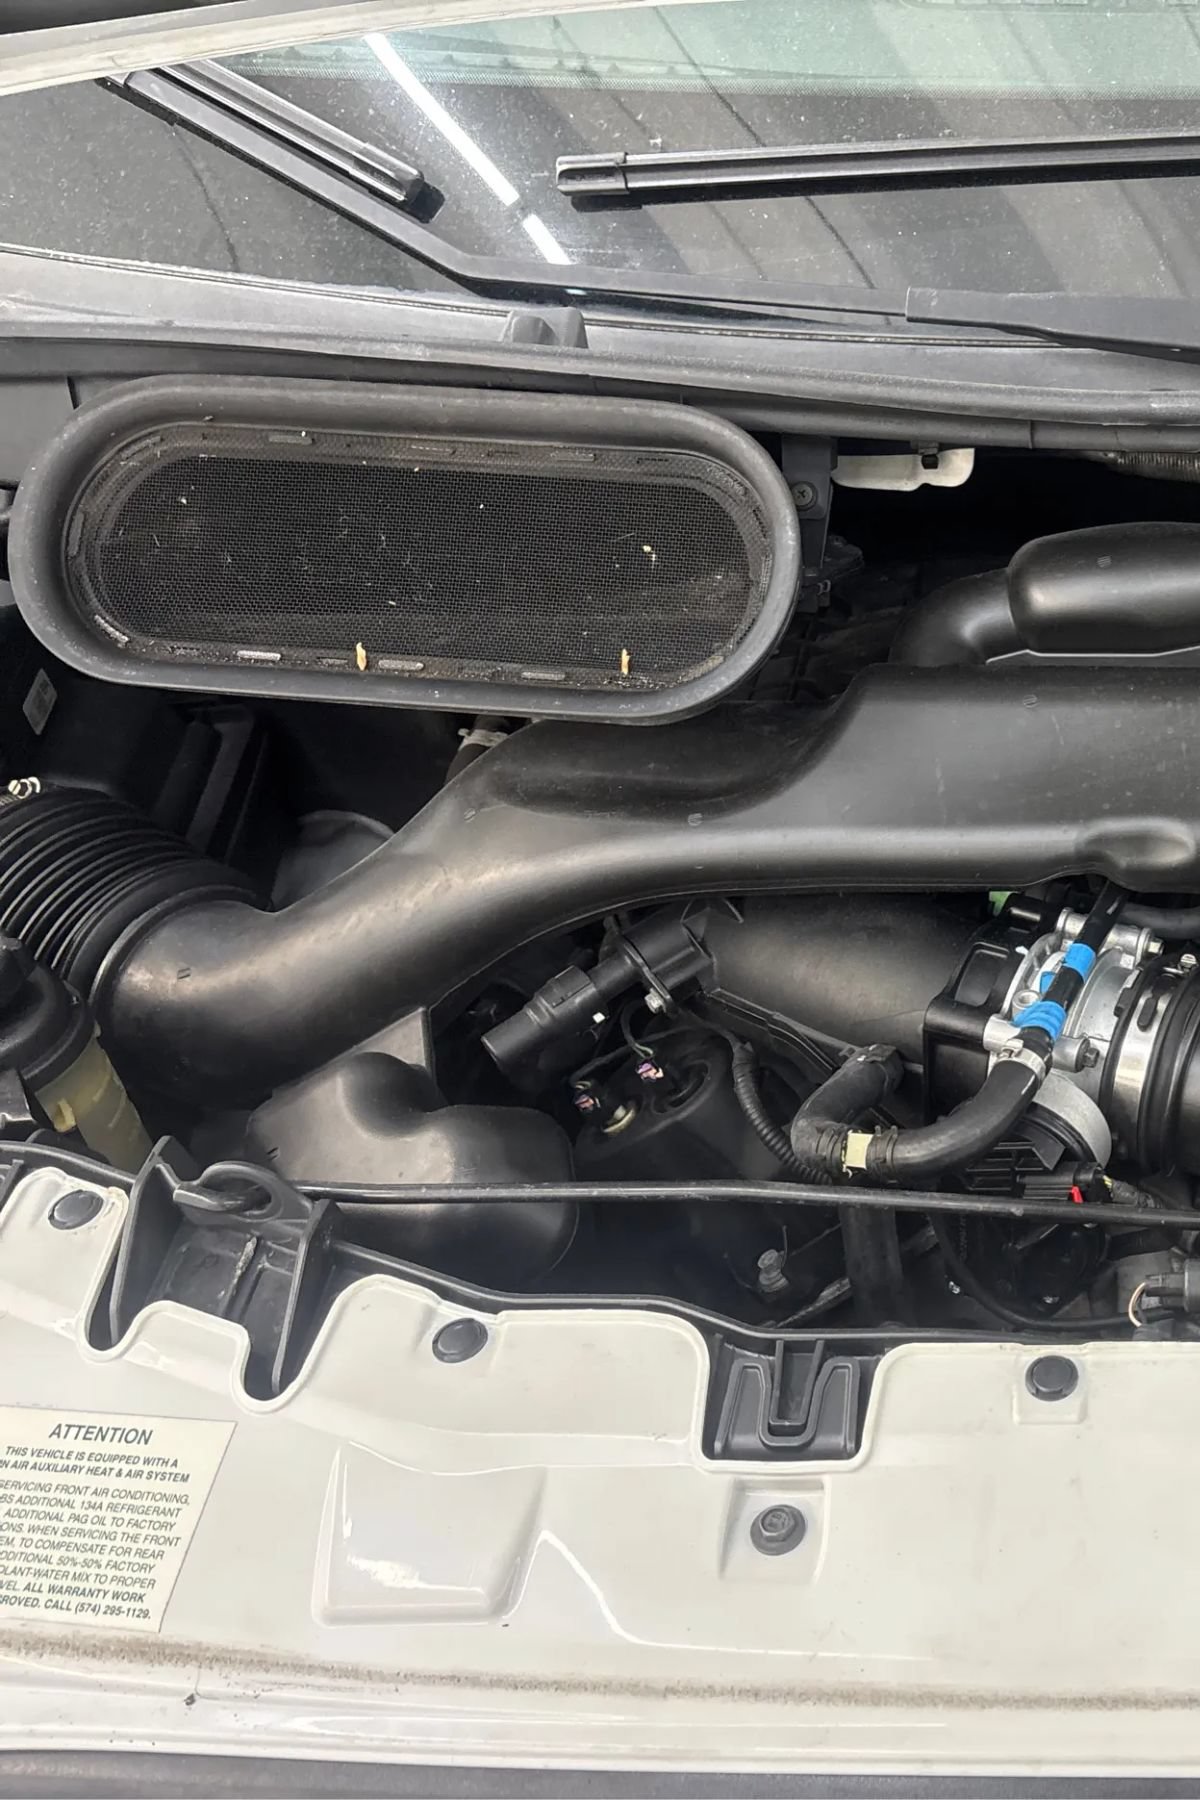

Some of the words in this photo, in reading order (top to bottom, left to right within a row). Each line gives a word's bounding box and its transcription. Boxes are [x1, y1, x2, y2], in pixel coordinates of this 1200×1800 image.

[49, 1423, 153, 1446] ATTENTION
[6, 1446, 28, 1457] THIS
[31, 1448, 74, 1460] VEHICLE
[75, 1451, 86, 1461] IS
[87, 1452, 140, 1466] EQUIPPED
[143, 1456, 170, 1467] WITH
[170, 1459, 178, 1468] A
[10, 1460, 29, 1470] AIR
[30, 1462, 85, 1475] AUXILIARY
[86, 1466, 114, 1478] HEAT
[115, 1468, 123, 1478] &
[124, 1469, 144, 1480] AIR
[146, 1470, 190, 1483] SYSTEM
[54, 1483, 90, 1497] FRONT
[91, 1486, 110, 1498] AIR
[111, 1488, 190, 1506] CONDITIONING,
[15, 1495, 76, 1510] ADDITIONAL
[80, 1500, 103, 1511] 134A
[105, 1502, 182, 1518] REFRIGERANT
[3, 1507, 64, 1522] ADDITIONAL
[67, 1512, 89, 1524] PAG
[90, 1514, 107, 1526] OIL
[110, 1516, 125, 1528] TO
[126, 1518, 177, 1533] FACTORY
[27, 1523, 60, 1536] WHEN
[60, 1526, 119, 1541] SERVICING
[119, 1532, 142, 1544] THE
[142, 1534, 182, 1547] FRONT
[20, 1537, 34, 1549] TO
[34, 1539, 108, 1555] COMPENSATE
[108, 1545, 132, 1557] FOR
[133, 1547, 165, 1561] REAR
[56, 1555, 103, 1570] 50%-50%
[104, 1560, 156, 1575] FACTORY
[71, 1570, 93, 1583] MIX
[93, 1573, 109, 1585] TO
[109, 1575, 157, 1590] PROPER
[23, 1581, 44, 1594] ALL
[47, 1583, 110, 1600] WARRANTY
[111, 1589, 147, 1604] WORK
[44, 1598, 73, 1612] CALL
[74, 1602, 101, 1617] (574)
[102, 1604, 151, 1620] 295-1129.
